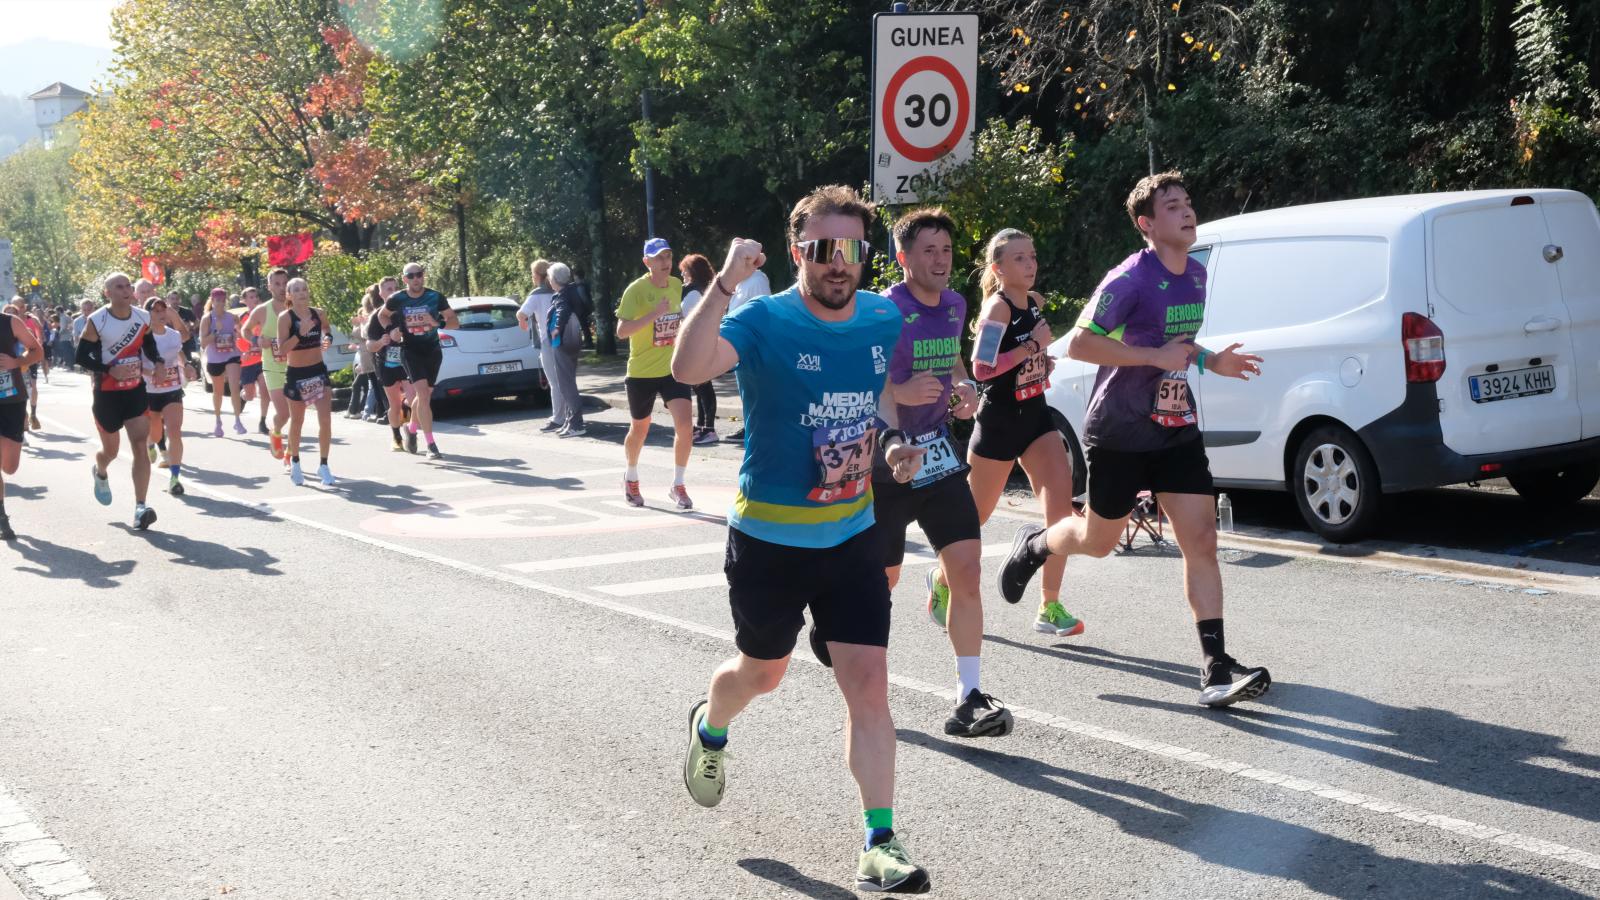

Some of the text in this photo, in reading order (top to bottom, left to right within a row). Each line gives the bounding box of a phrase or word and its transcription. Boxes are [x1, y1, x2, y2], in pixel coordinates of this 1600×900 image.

[891, 27, 964, 47] GUNEA
[904, 93, 951, 128] 30
[1483, 374, 1520, 396] 3924
[1523, 370, 1551, 390] KHH
[822, 390, 874, 407] MEDIA
[924, 464, 945, 476] MARC
